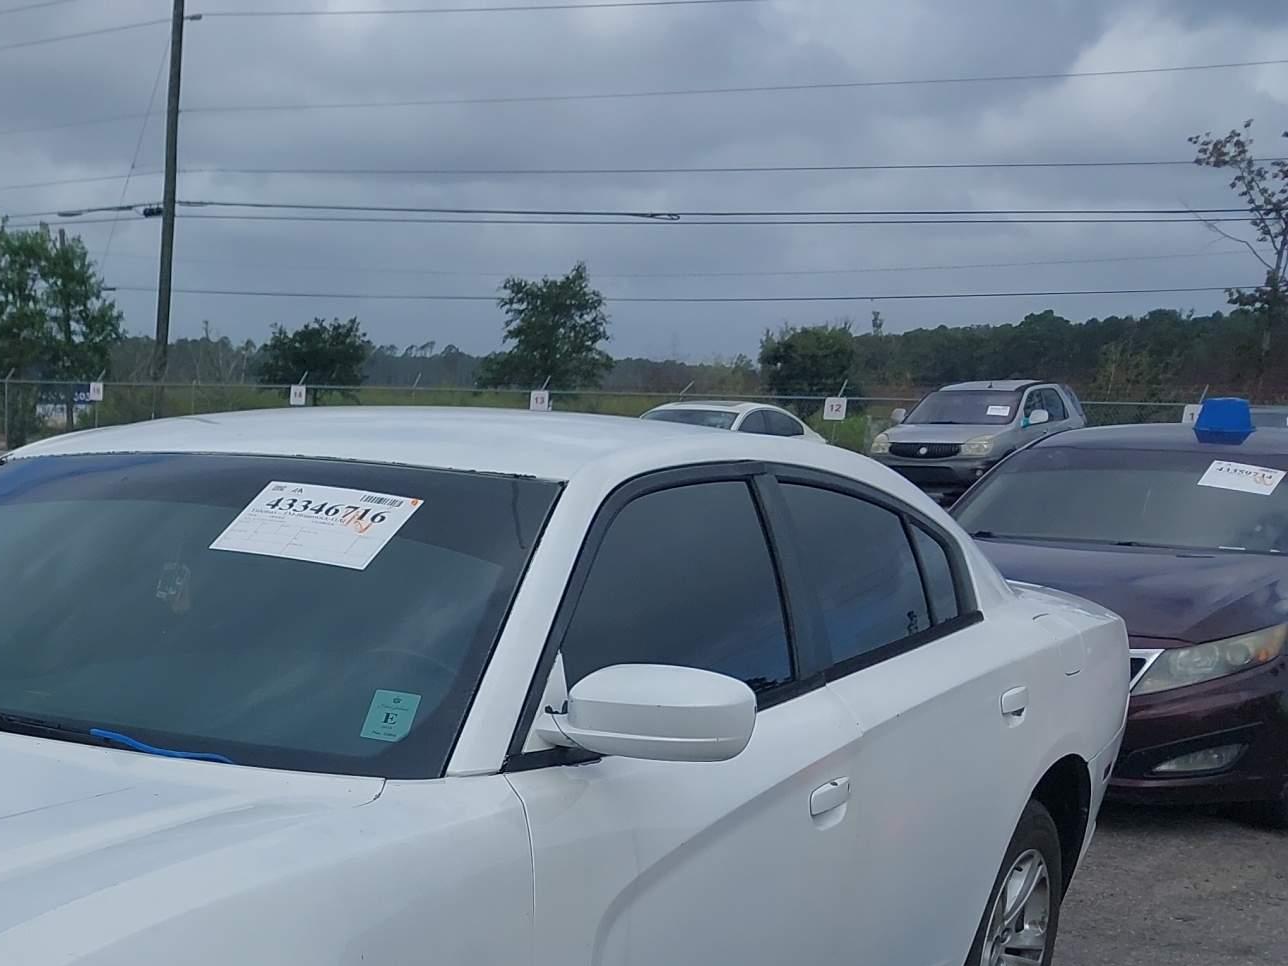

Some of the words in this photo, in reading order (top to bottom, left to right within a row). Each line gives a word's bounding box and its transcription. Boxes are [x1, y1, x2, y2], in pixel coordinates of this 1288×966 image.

[830, 404, 841, 413] 12
[265, 497, 392, 524] 43346716
[381, 712, 397, 725] E
